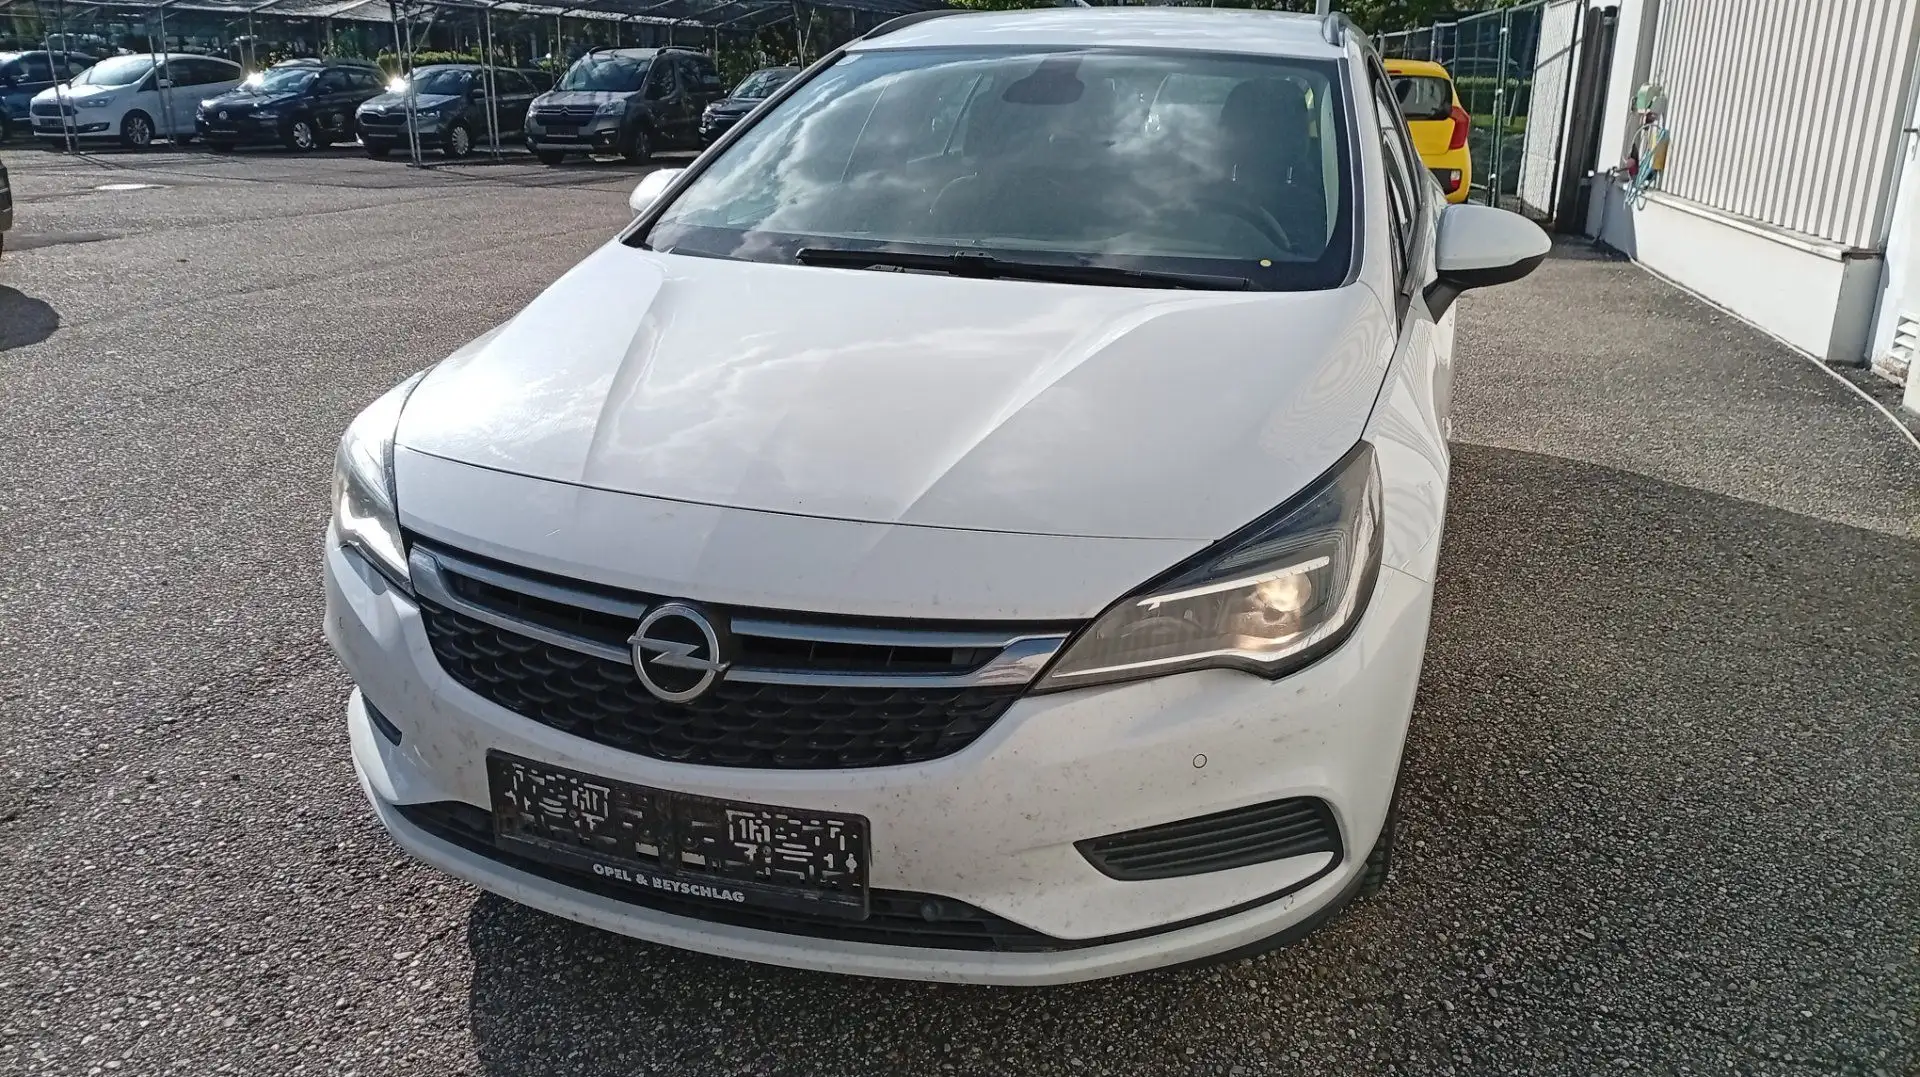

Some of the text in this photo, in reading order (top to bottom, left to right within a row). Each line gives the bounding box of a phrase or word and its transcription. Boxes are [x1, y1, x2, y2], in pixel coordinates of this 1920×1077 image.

[592, 863, 745, 903] OPEL & BEYSCHLAG
